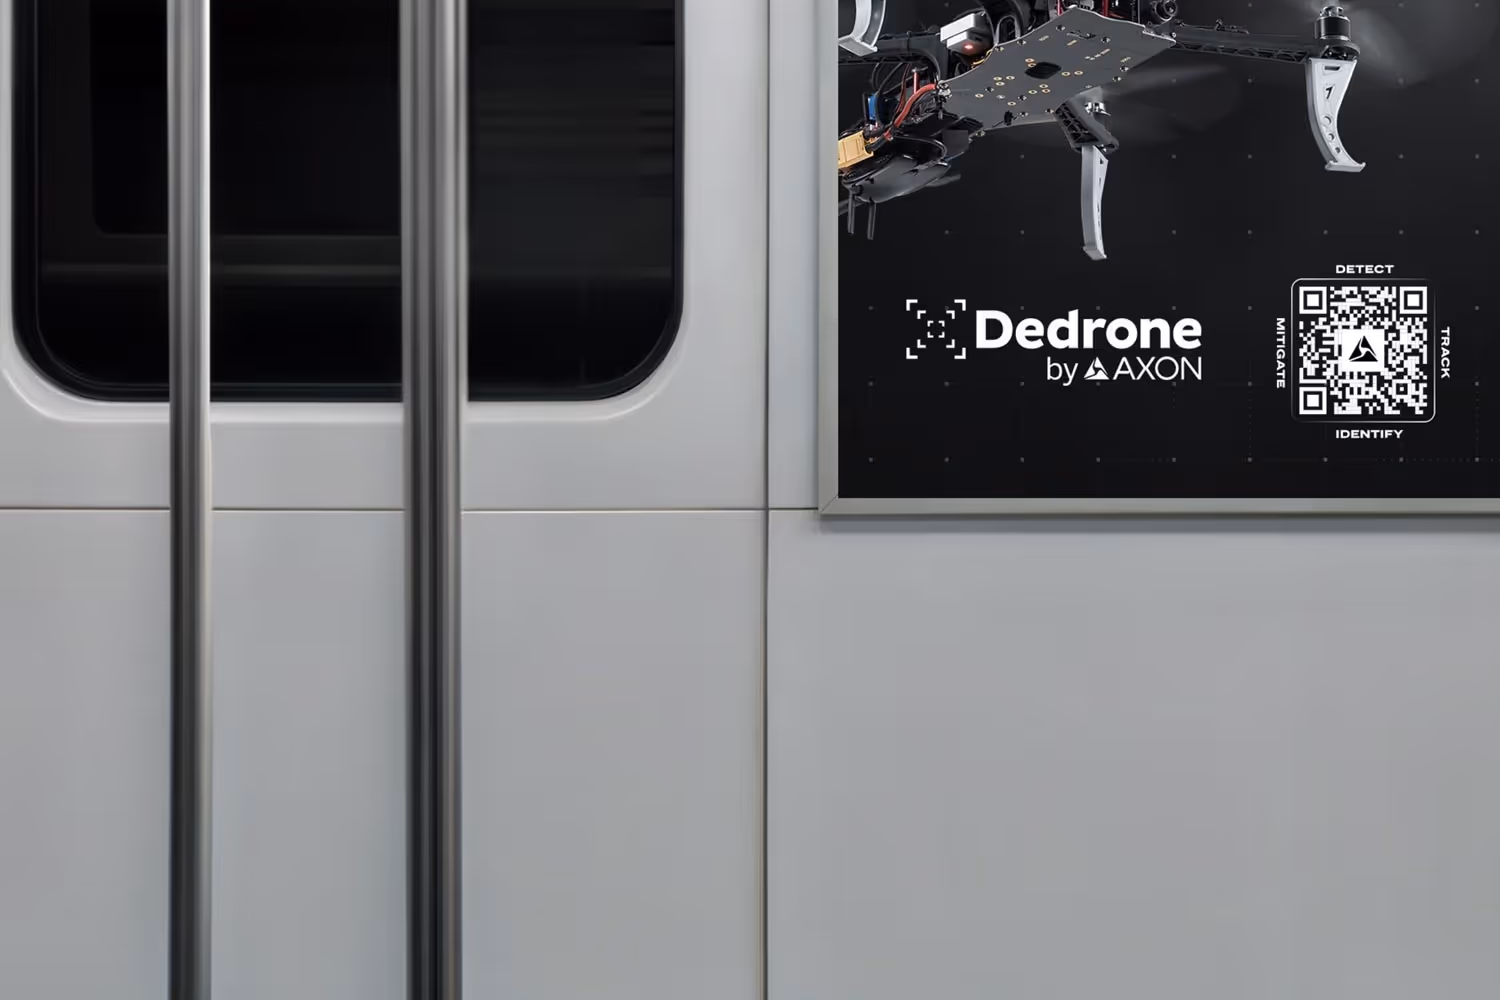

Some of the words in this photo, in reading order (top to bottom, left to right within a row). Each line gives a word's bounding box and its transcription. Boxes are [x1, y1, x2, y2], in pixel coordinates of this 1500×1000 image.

[1335, 264, 1395, 274] DETECT
[976, 308, 1203, 350] Dedrone
[1276, 317, 1286, 389] MITIGATE
[1440, 326, 1451, 379] TRACK
[1046, 356, 1079, 387] by
[1112, 356, 1202, 381] AXON
[1335, 429, 1404, 439] IDENTIFY
